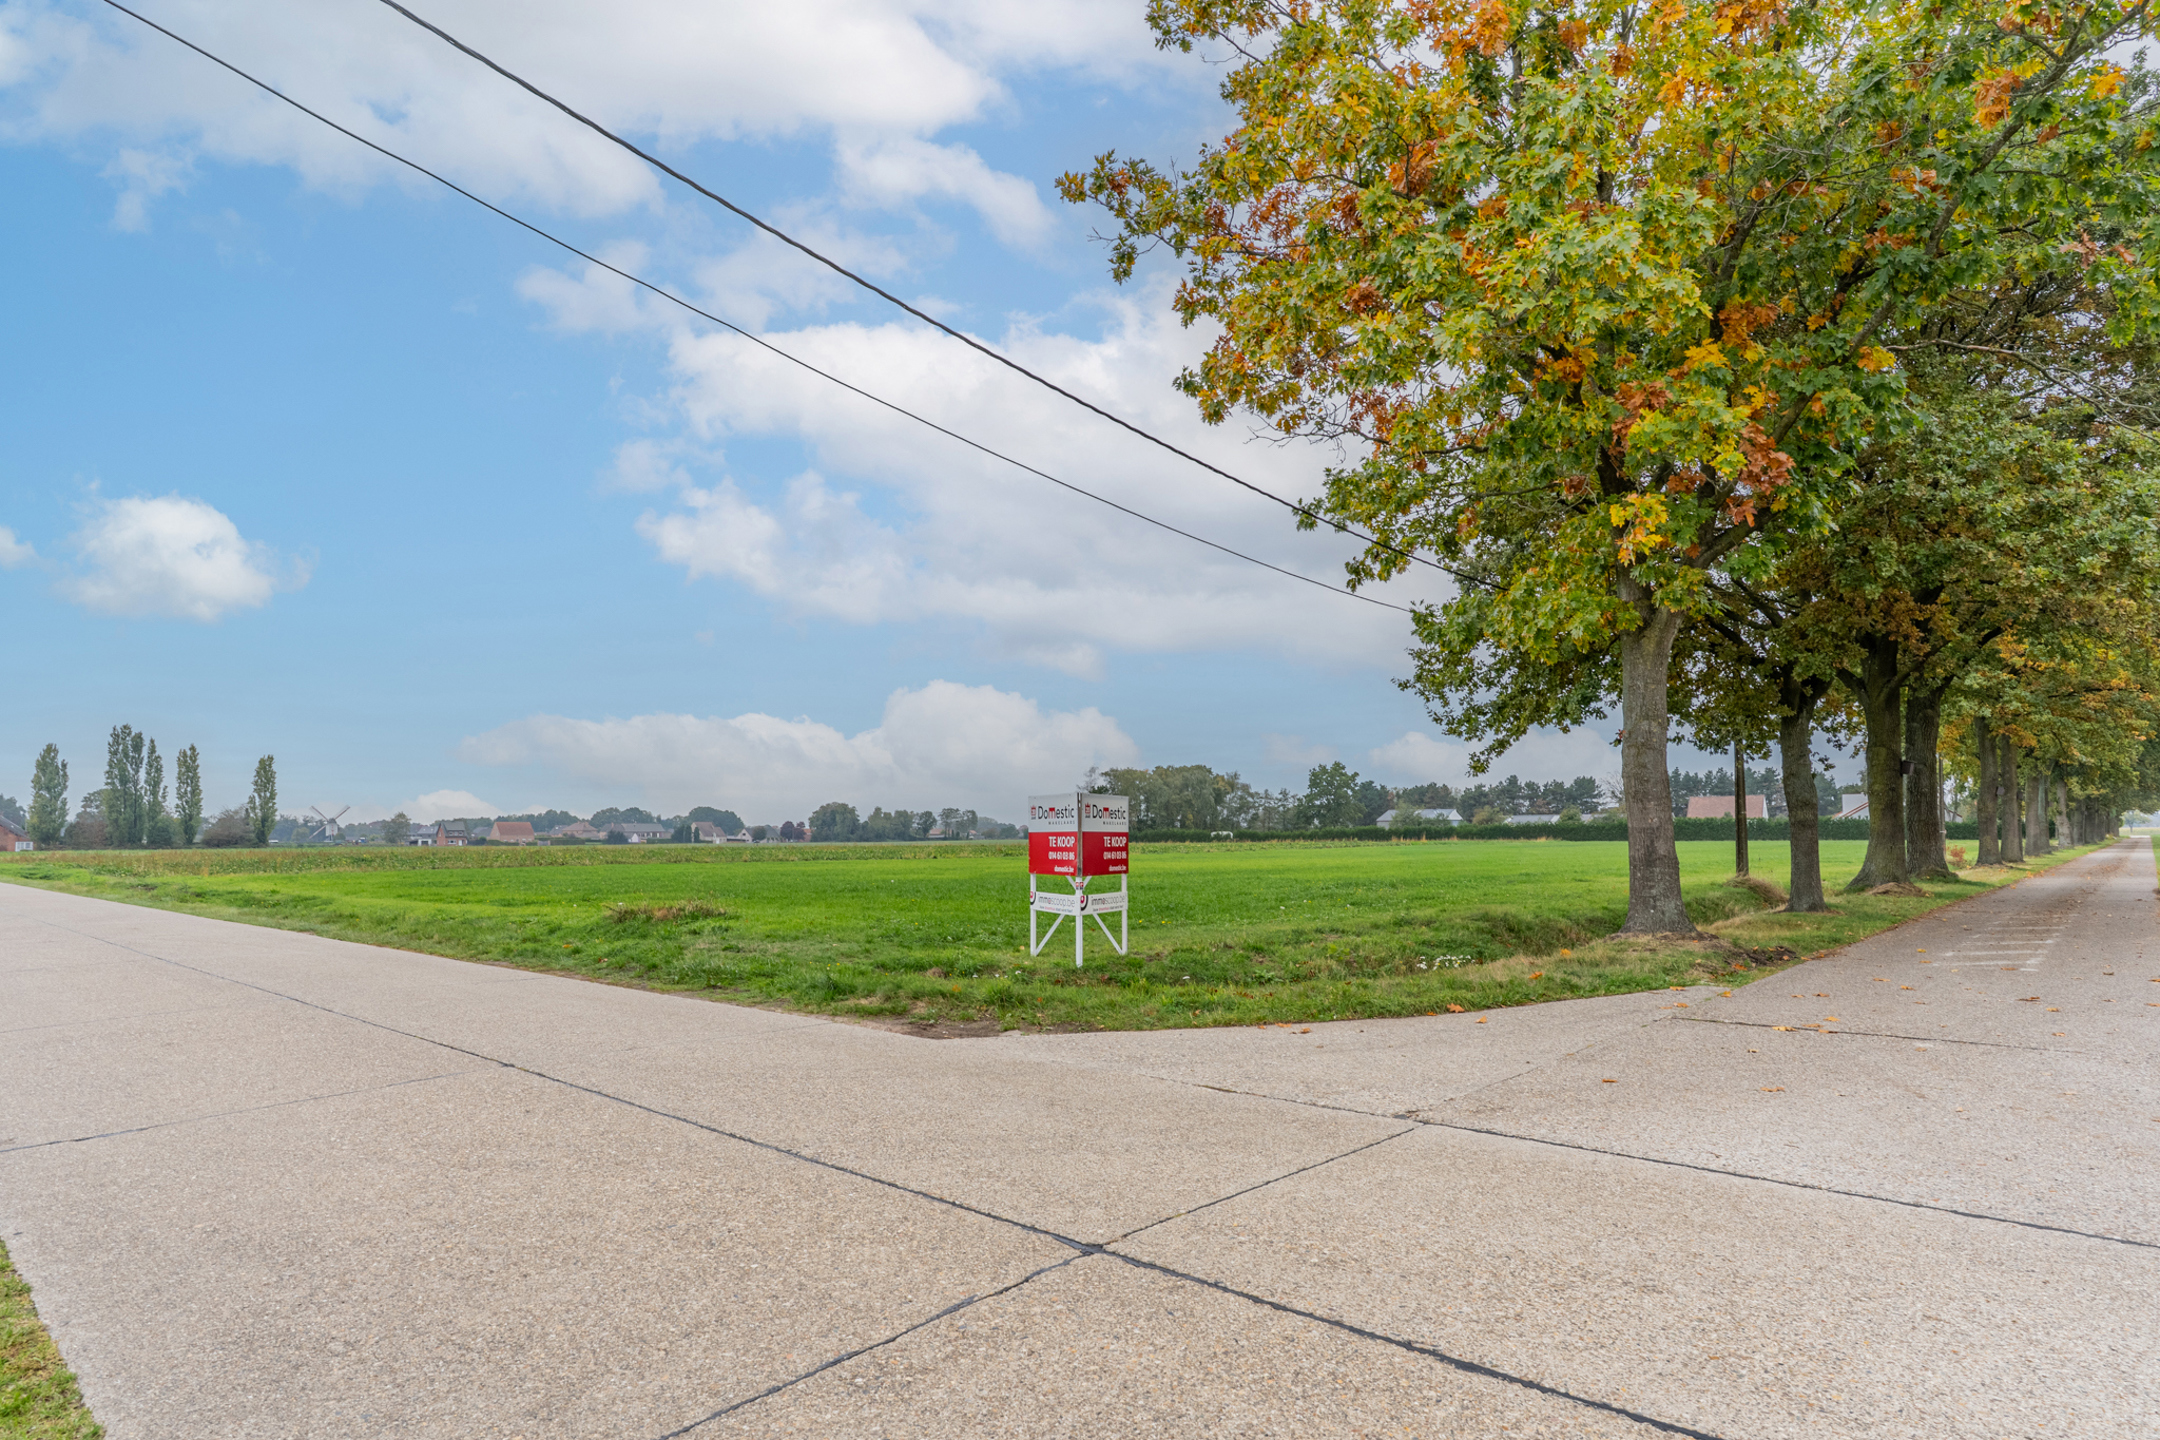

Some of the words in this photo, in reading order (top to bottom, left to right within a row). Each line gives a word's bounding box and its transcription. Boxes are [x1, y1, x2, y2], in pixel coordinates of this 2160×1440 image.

[1038, 804, 1075, 819] Domestic
[1092, 804, 1126, 819] Domestic
[1048, 836, 1056, 847] TE
[1057, 836, 1075, 847] KOOP
[1103, 836, 1111, 847] TE
[1111, 836, 1127, 847] KOOP
[1054, 865, 1074, 873] domestic.be
[1038, 893, 1075, 907] immoscoop.be
